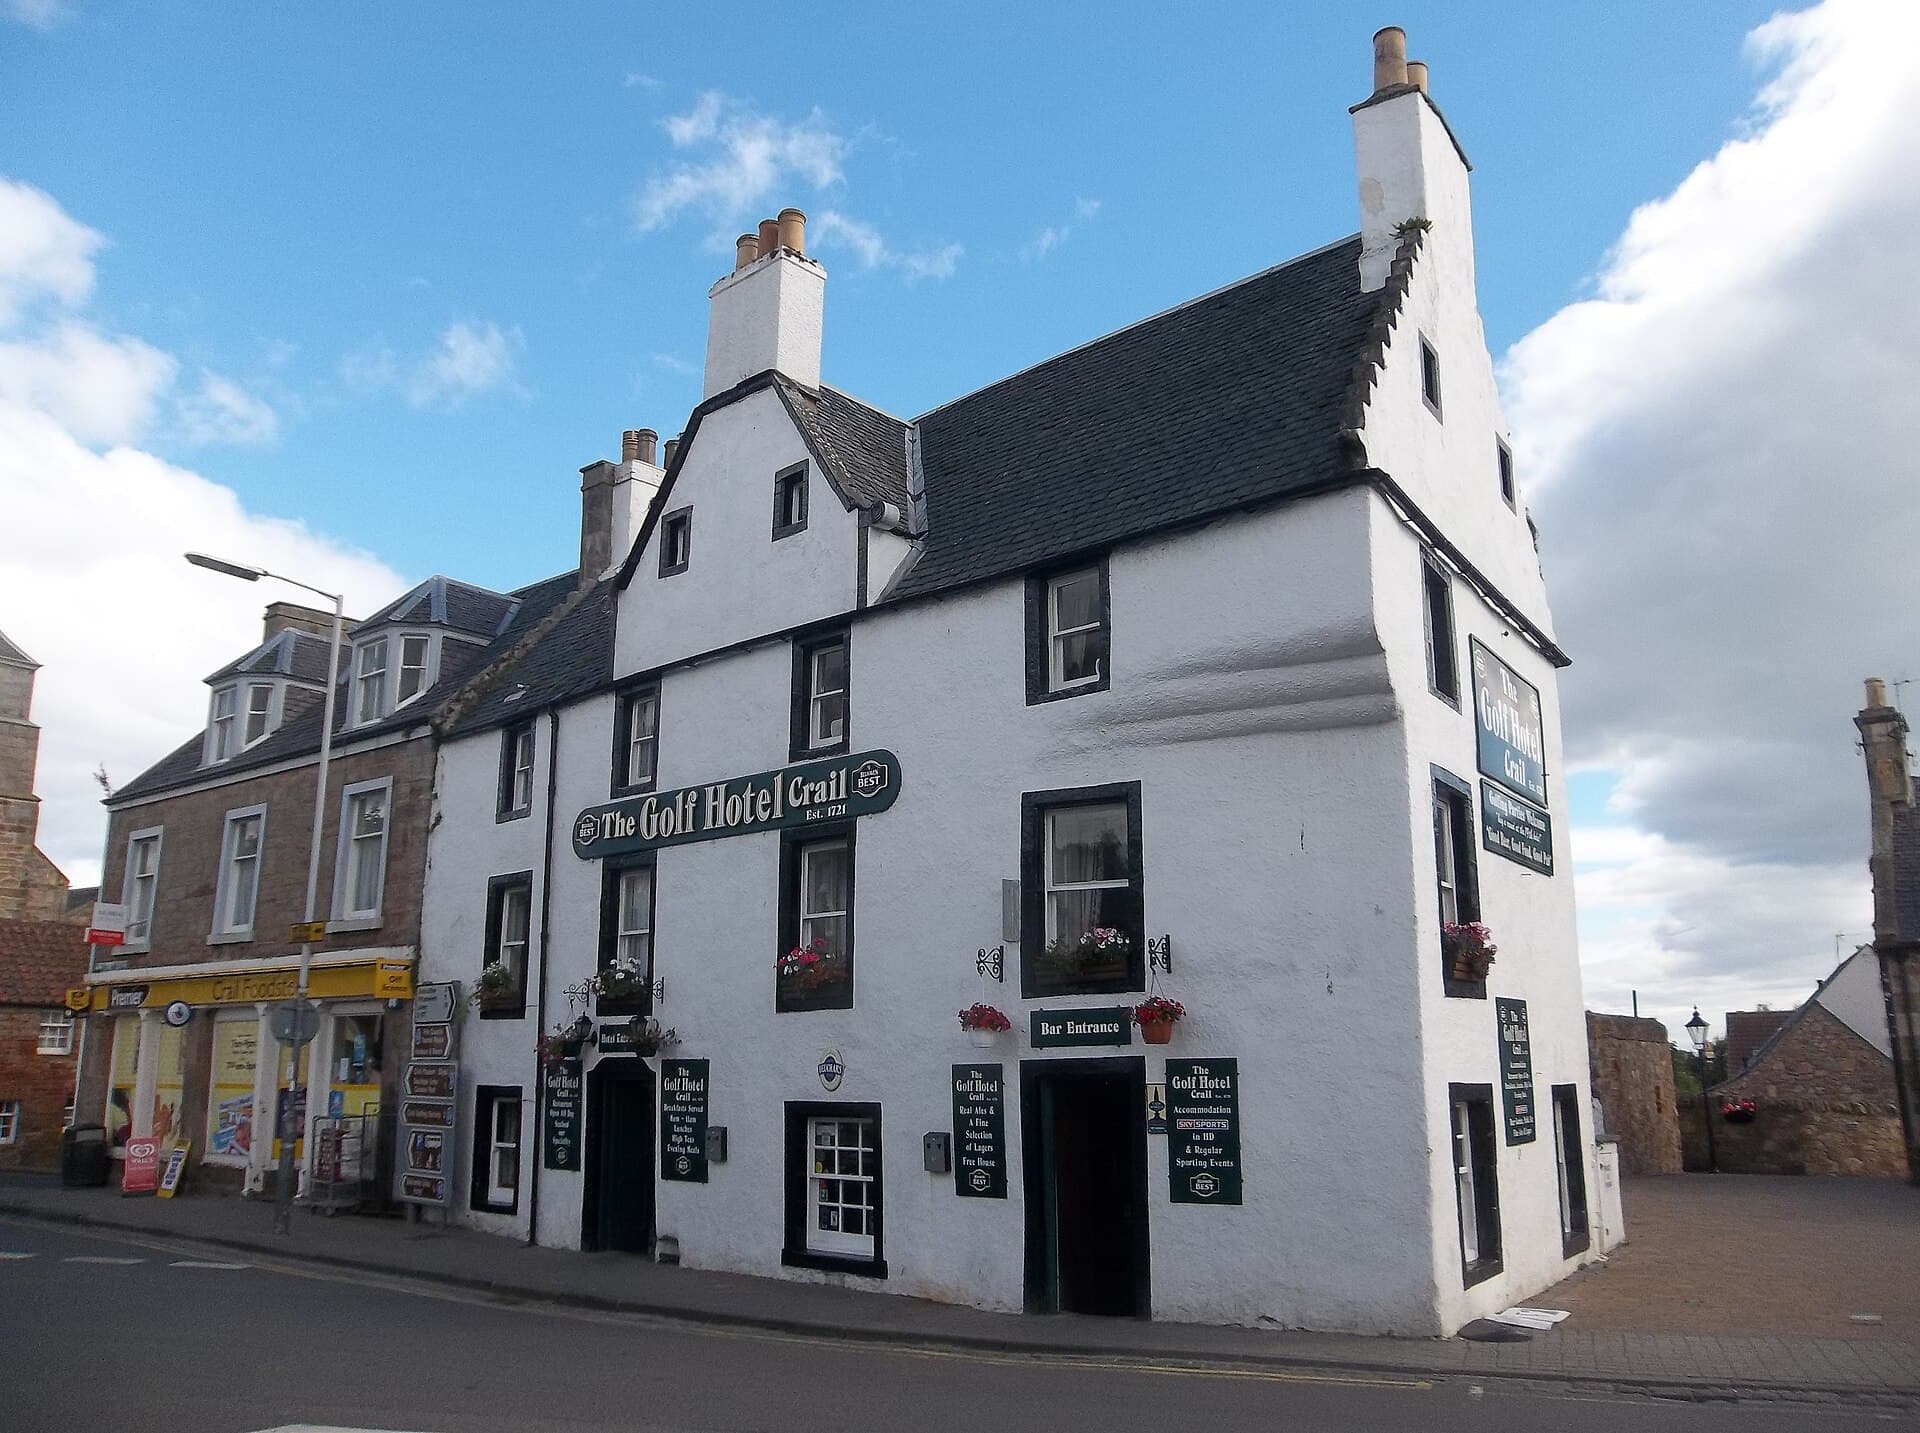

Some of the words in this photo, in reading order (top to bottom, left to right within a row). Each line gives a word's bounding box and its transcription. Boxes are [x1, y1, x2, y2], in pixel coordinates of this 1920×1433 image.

[1500, 666, 1518, 703] The
[1481, 686, 1508, 742] Golf
[1510, 705, 1541, 765] Hotel
[1504, 749, 1526, 787] Crail
[858, 775, 881, 788] BEST
[602, 811, 636, 839] The
[639, 790, 698, 841] Golf
[703, 772, 785, 831] Hotel
[788, 767, 848, 808] Crail
[805, 808, 824, 821] Est.
[827, 803, 847, 817] 1721
[579, 827, 595, 838] BEST
[111, 986, 144, 1007] Premier
[1040, 1022, 1062, 1035] Bar
[1066, 1021, 1120, 1035] Entrance
[678, 1067, 689, 1077] The
[970, 1070, 983, 1079] The
[1192, 1065, 1209, 1075] The
[547, 1075, 561, 1088] Golf
[562, 1076, 579, 1089] Hotel
[664, 1077, 681, 1092] Golf
[682, 1077, 704, 1092] Hotel
[956, 1079, 974, 1092] Golf
[975, 1079, 998, 1092] Hotel
[1172, 1075, 1197, 1089] Golf
[1198, 1075, 1231, 1089] Hotel
[675, 1092, 691, 1102] Crail
[969, 1092, 985, 1101] Crail
[1190, 1089, 1212, 1099] Crail
[688, 1104, 704, 1113] Served
[959, 1105, 973, 1115] Real
[974, 1106, 987, 1115] Ales
[989, 1105, 995, 1115] &
[1173, 1105, 1232, 1114] Accommodation
[968, 1118, 974, 1127] A
[975, 1118, 989, 1127] Fine
[673, 1124, 693, 1133] Lunches
[671, 1134, 684, 1144] High
[965, 1129, 993, 1140] Selection
[1203, 1132, 1215, 1141] HD
[667, 1144, 686, 1155] Evening
[686, 1145, 700, 1154] Meals
[965, 1142, 972, 1152] of
[974, 1142, 994, 1154] Lagers
[1185, 1145, 1192, 1154] &
[1194, 1145, 1223, 1156] Regular
[962, 1156, 976, 1166] Free
[977, 1157, 996, 1167] House
[1176, 1157, 1208, 1169] Sporting
[1210, 1158, 1234, 1167] Events
[1195, 1183, 1215, 1191] BEST
